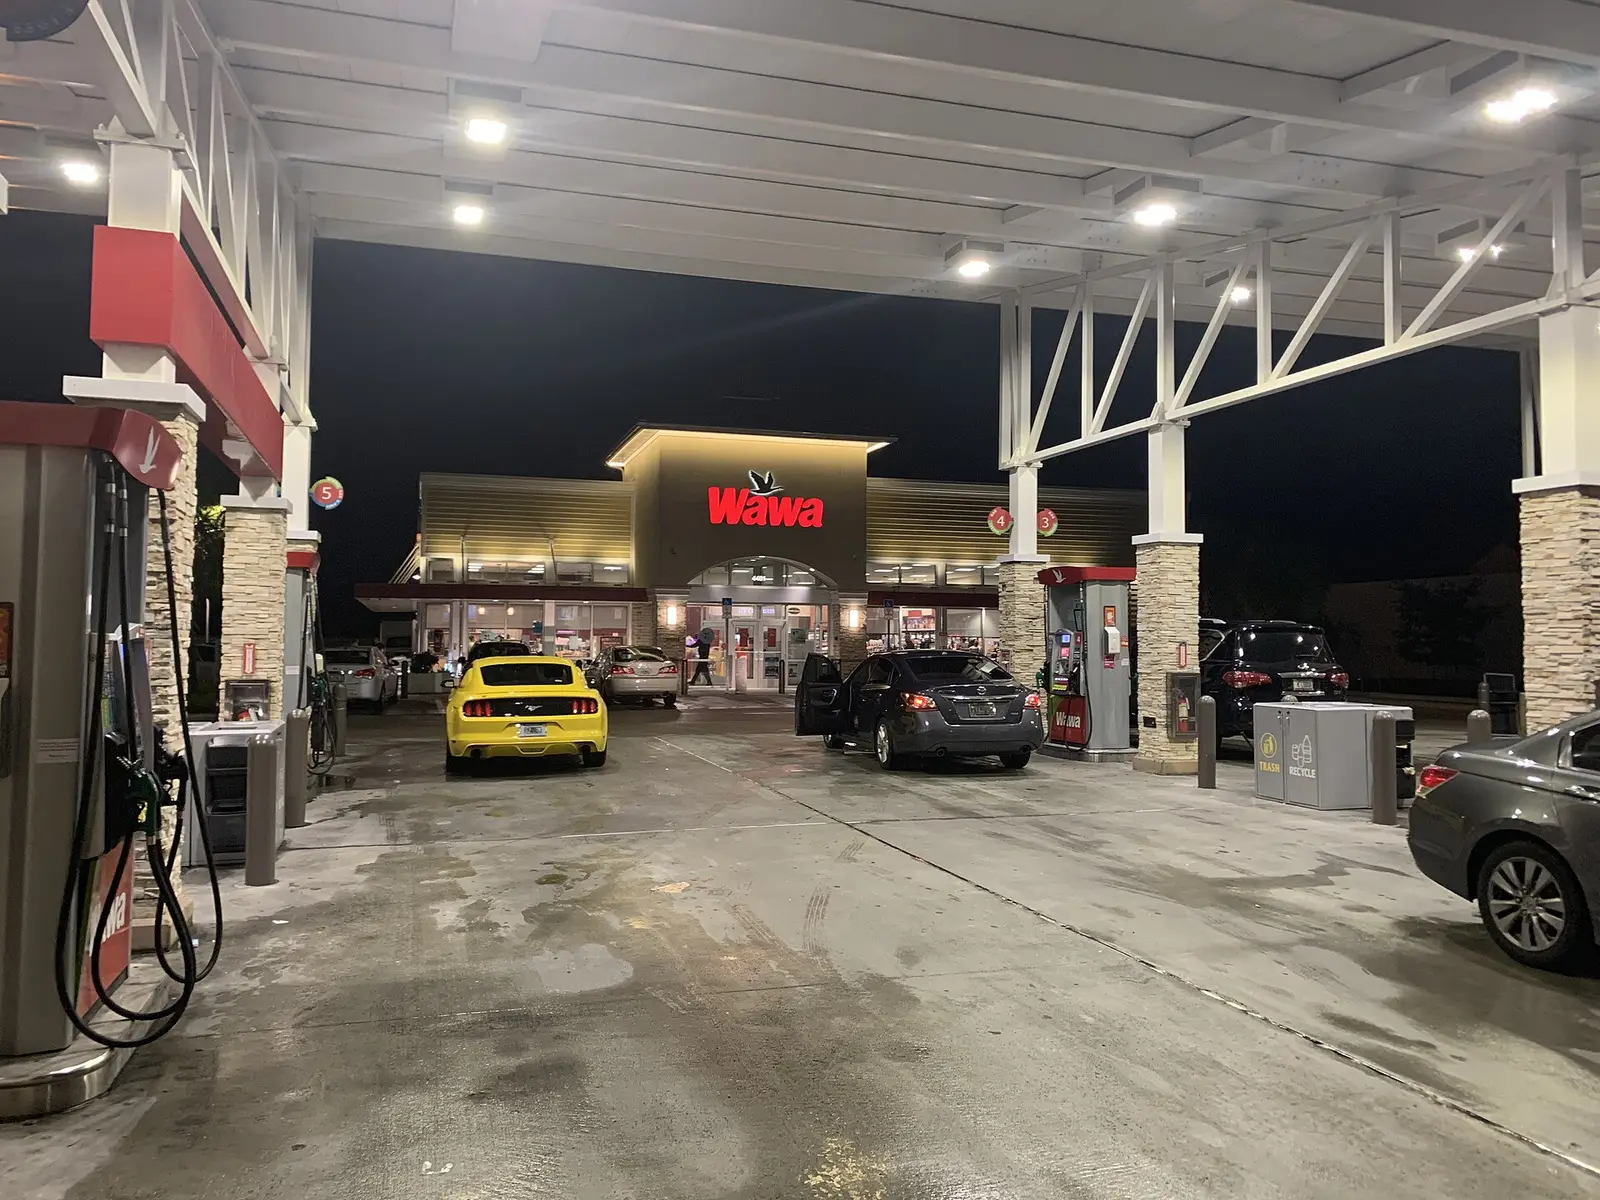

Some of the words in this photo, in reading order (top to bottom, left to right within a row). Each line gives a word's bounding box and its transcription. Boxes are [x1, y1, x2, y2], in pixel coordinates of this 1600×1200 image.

[321, 486, 332, 500] 5
[708, 486, 824, 528] Wawa
[996, 515, 1006, 527] 4
[1041, 517, 1050, 529] 3
[1259, 761, 1280, 773] TRASH
[1289, 766, 1316, 779] RECYCLE
